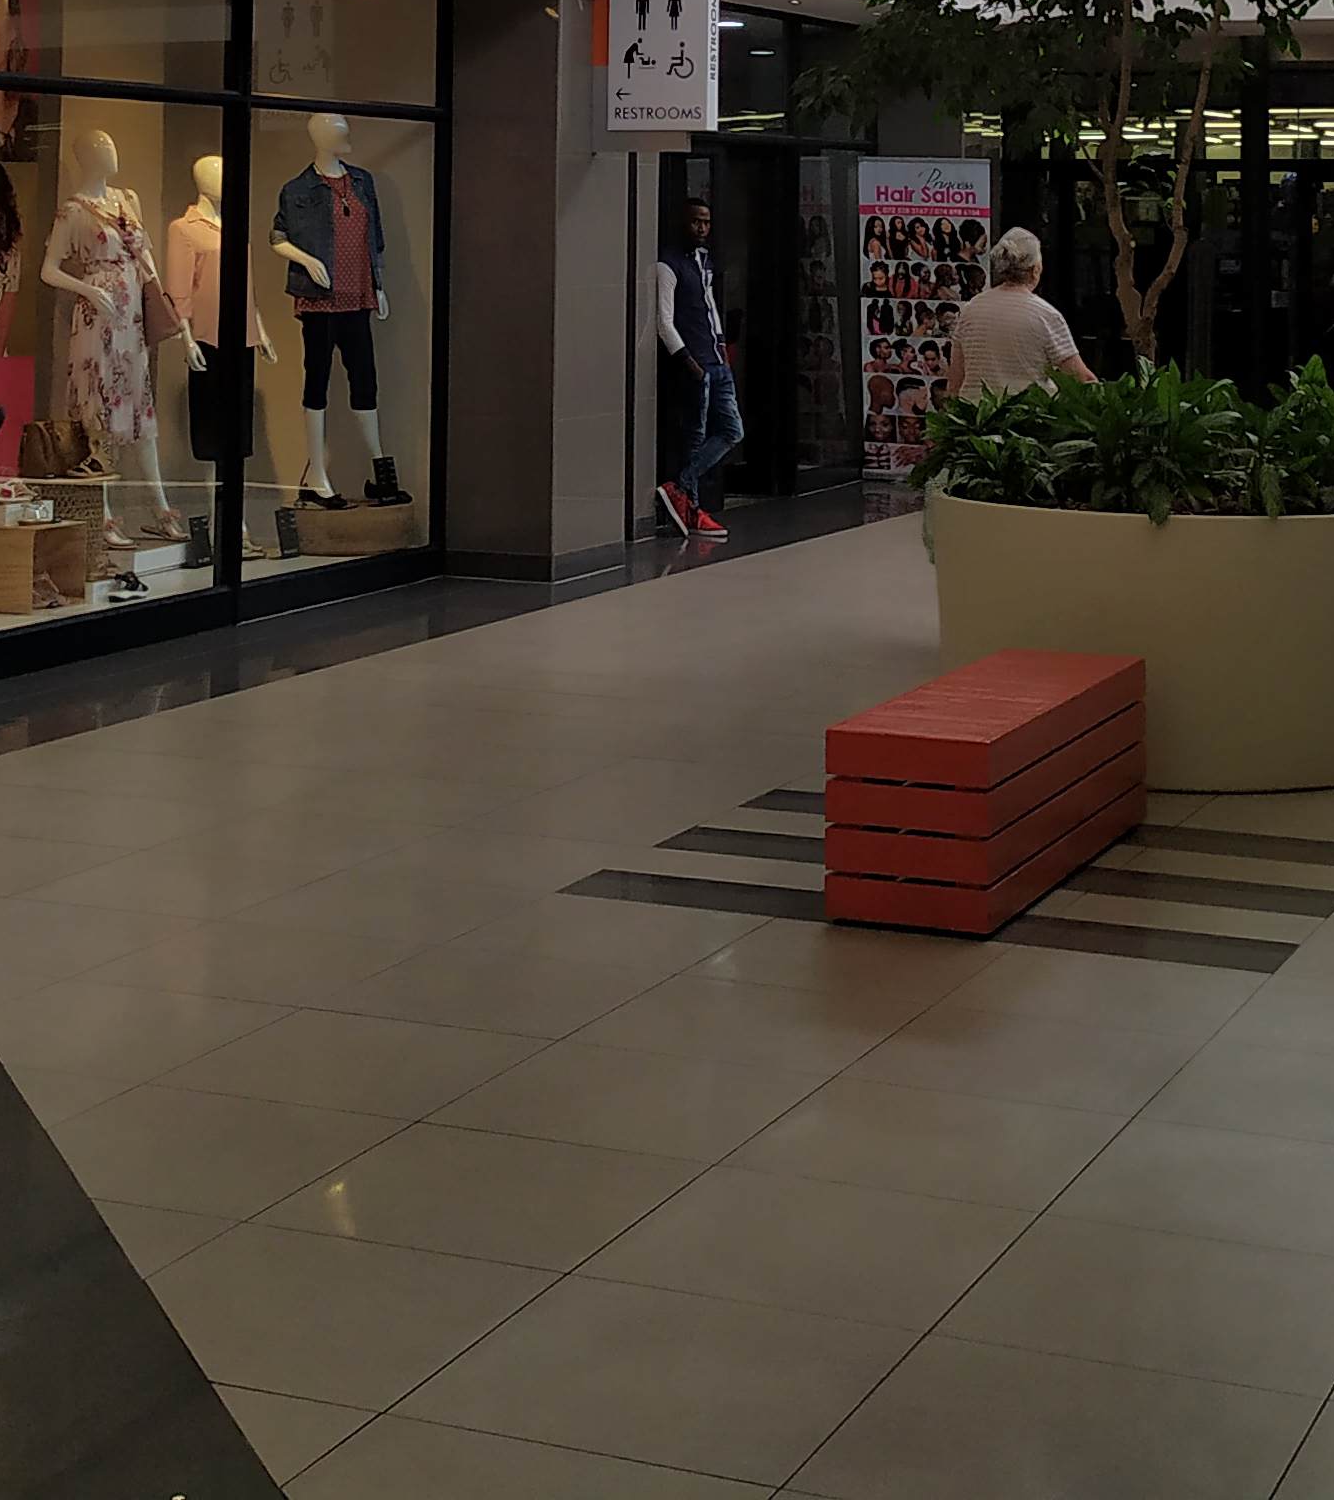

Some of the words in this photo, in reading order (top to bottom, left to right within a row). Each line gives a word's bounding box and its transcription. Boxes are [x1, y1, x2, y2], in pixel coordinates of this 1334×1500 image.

[614, 106, 703, 121] RESTROOMS
[875, 184, 916, 202] Hair
[920, 185, 977, 205] Salon
